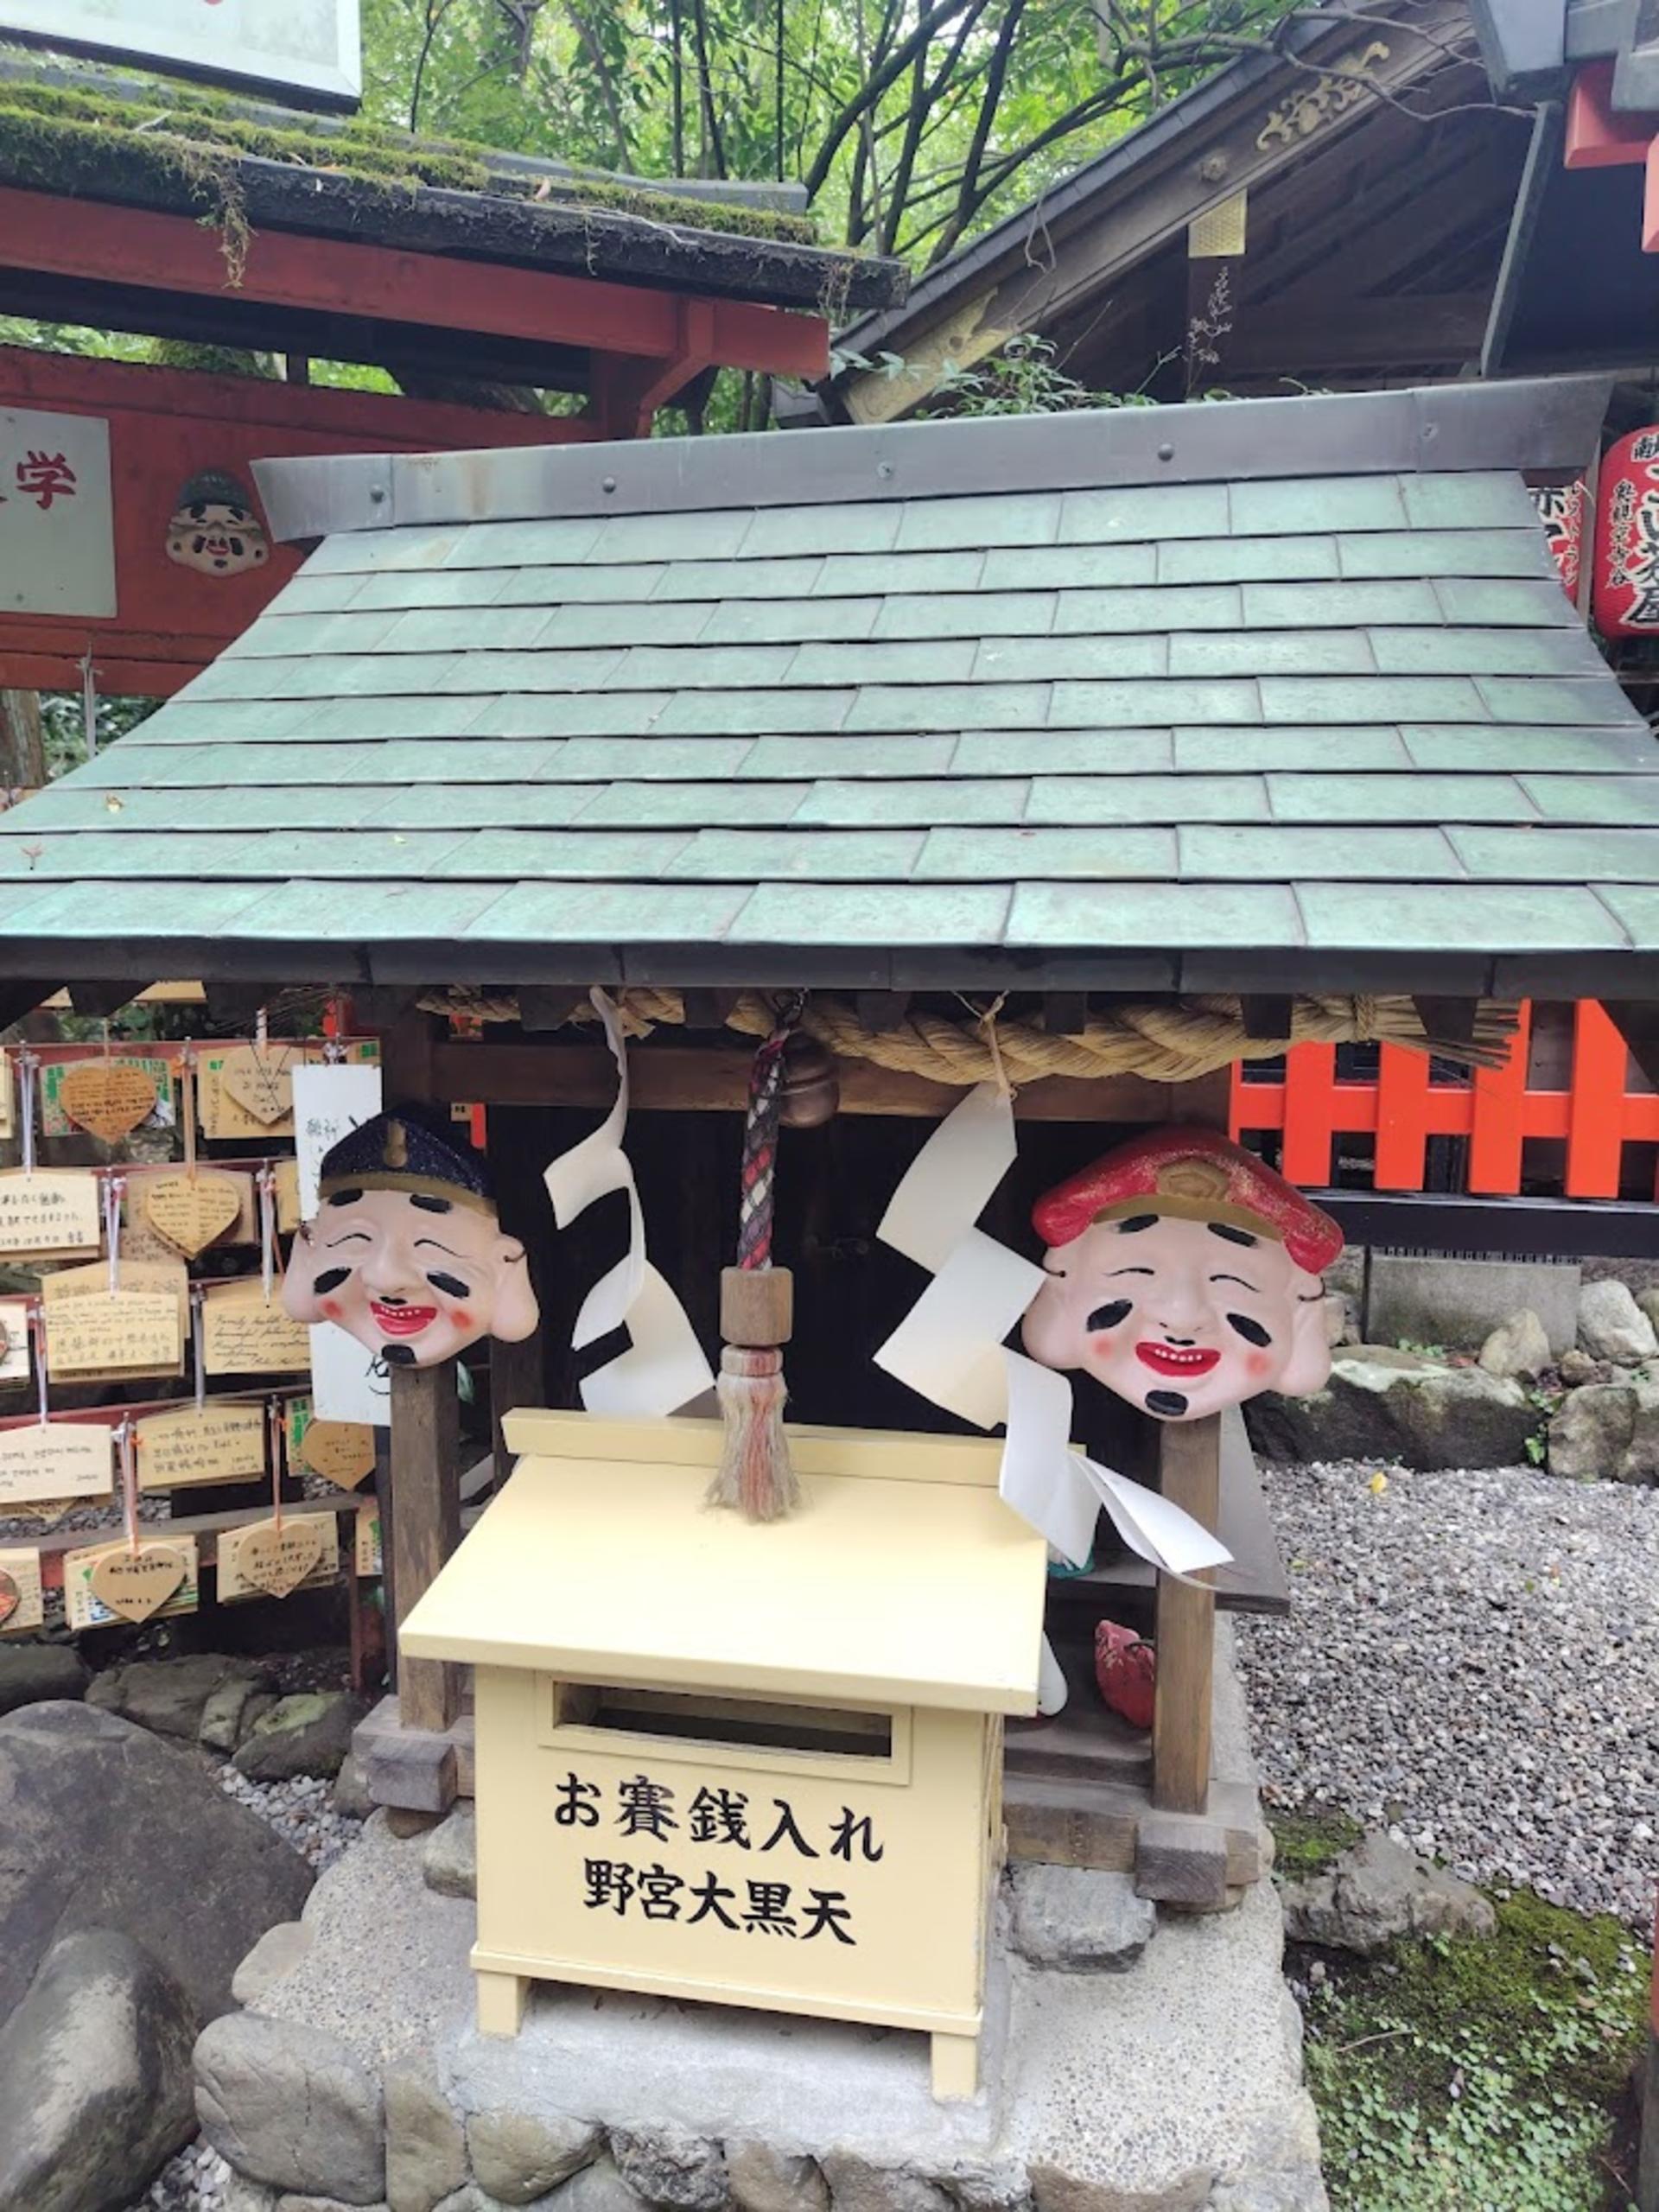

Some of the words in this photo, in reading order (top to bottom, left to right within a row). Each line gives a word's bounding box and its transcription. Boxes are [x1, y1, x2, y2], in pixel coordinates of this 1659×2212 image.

[0, 450, 76, 510] 学
[554, 1772, 884, 1862] お賽銭入れ
[583, 1858, 857, 1946] 野宮大黒天
